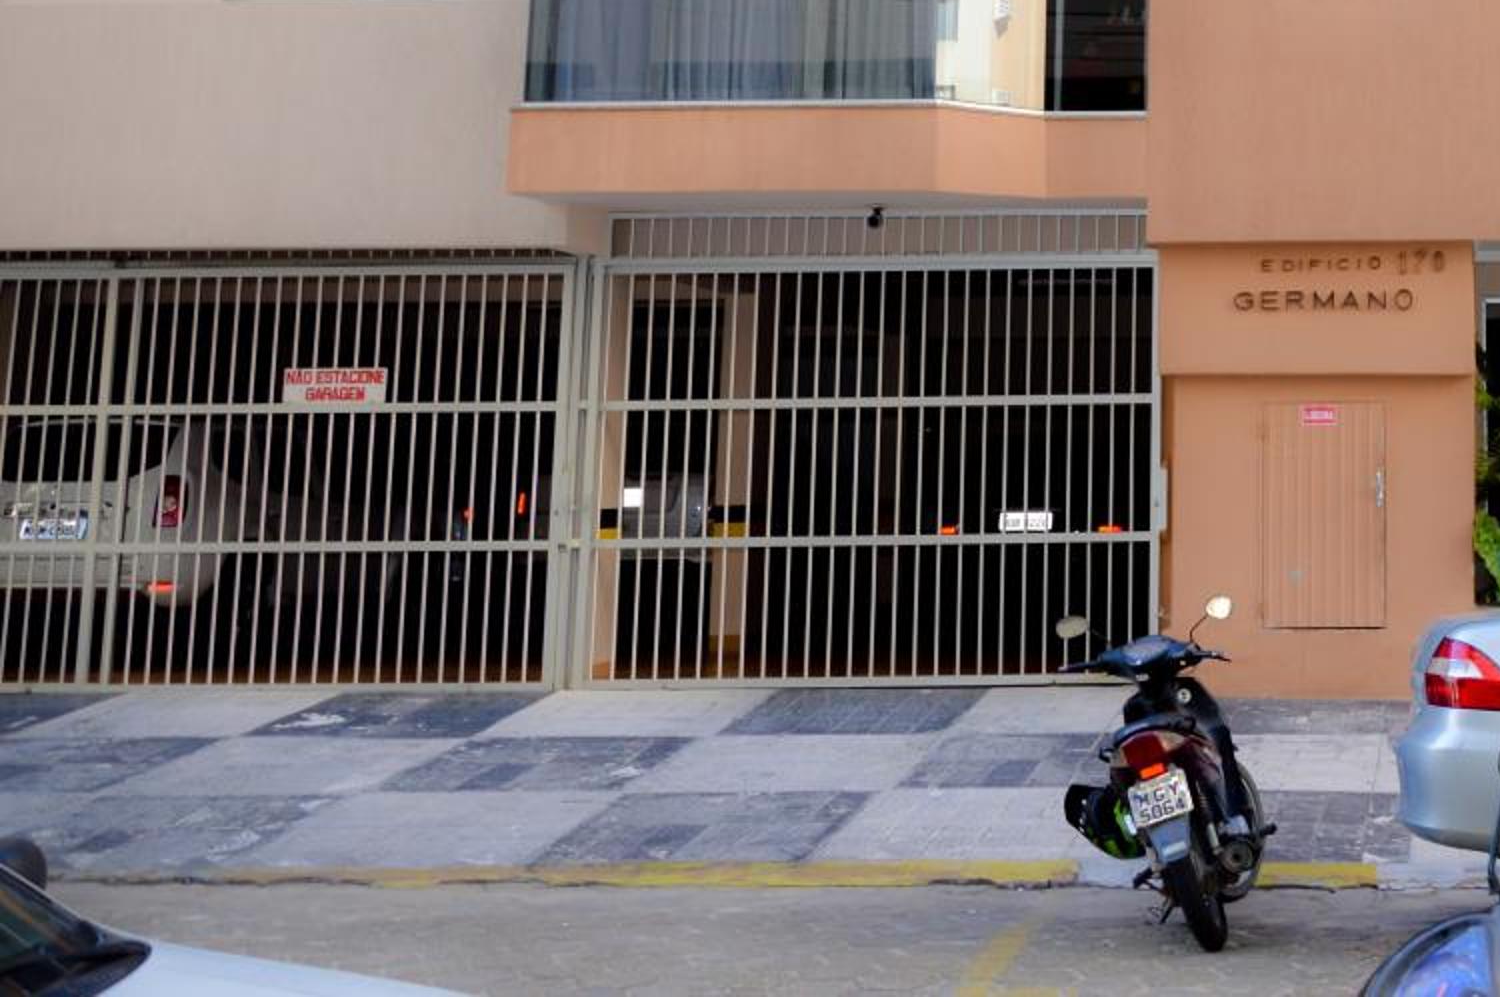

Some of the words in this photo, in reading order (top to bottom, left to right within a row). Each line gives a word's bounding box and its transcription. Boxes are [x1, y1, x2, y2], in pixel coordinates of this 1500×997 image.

[1259, 255, 1382, 273] EDIFICIO
[1233, 288, 1414, 312] GERMANO
[316, 369, 384, 384] ESTACIONE
